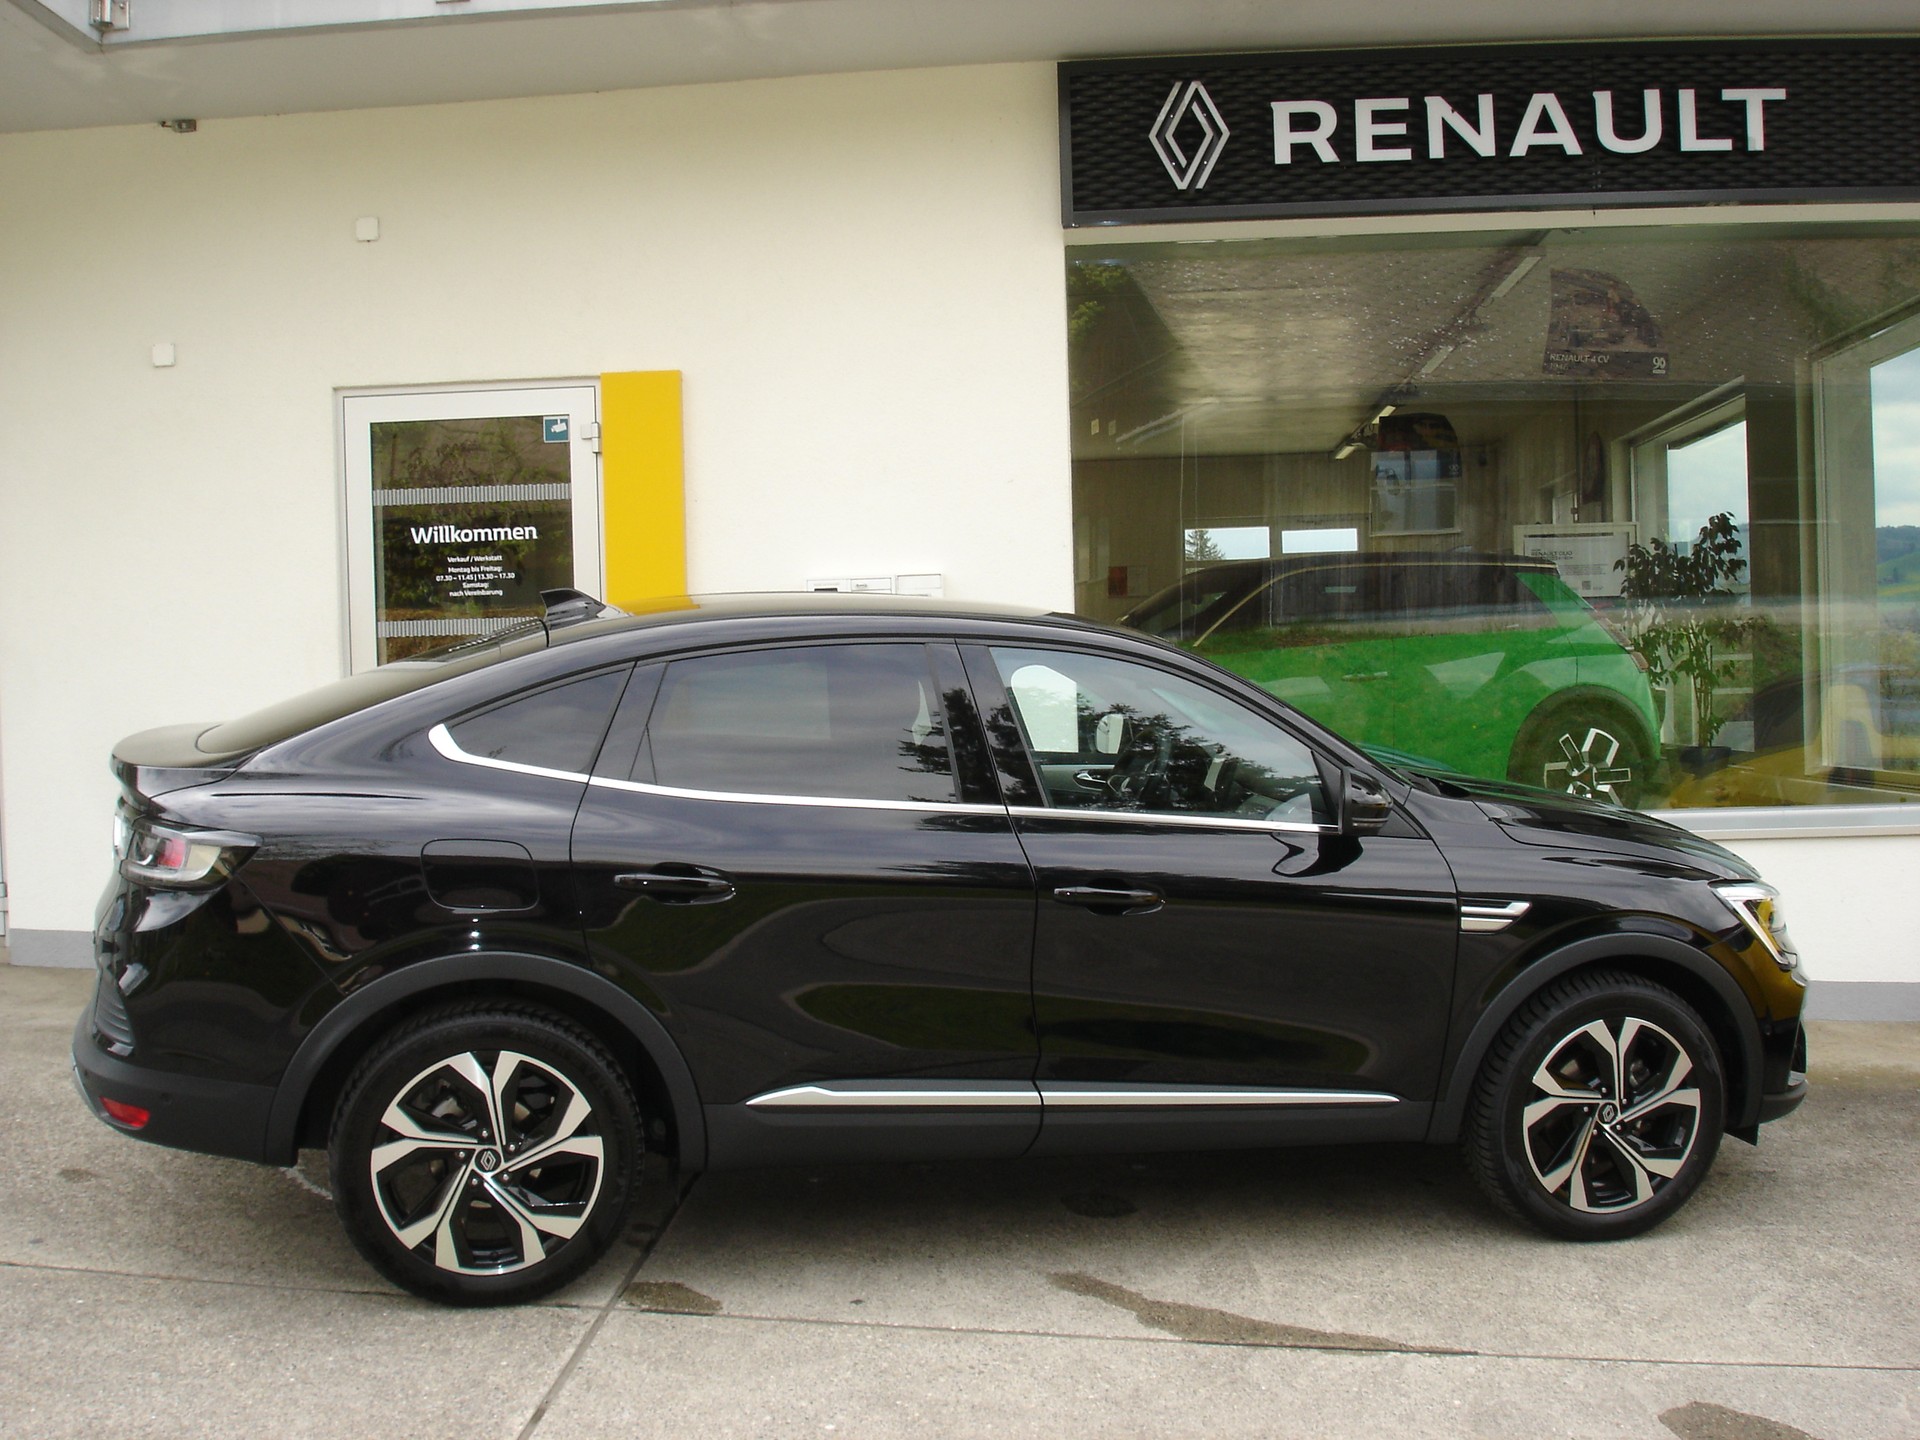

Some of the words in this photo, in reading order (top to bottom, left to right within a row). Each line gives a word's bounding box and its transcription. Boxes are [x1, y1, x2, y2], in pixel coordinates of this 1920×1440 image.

[1271, 87, 1788, 166] RENAULT
[1549, 353, 1590, 363] RENAULT
[1597, 354, 1610, 363] CV
[1652, 356, 1666, 370] 90
[410, 525, 538, 544] Willkommen
[447, 555, 470, 563] Verkauf
[448, 566, 471, 574] Montag
[470, 565, 480, 573] bis
[480, 565, 503, 573] Freitag:
[436, 574, 453, 582] 07.30
[458, 573, 474, 581] 11.45
[477, 572, 494, 580] 13.30
[464, 589, 504, 597] Vereinbarung
